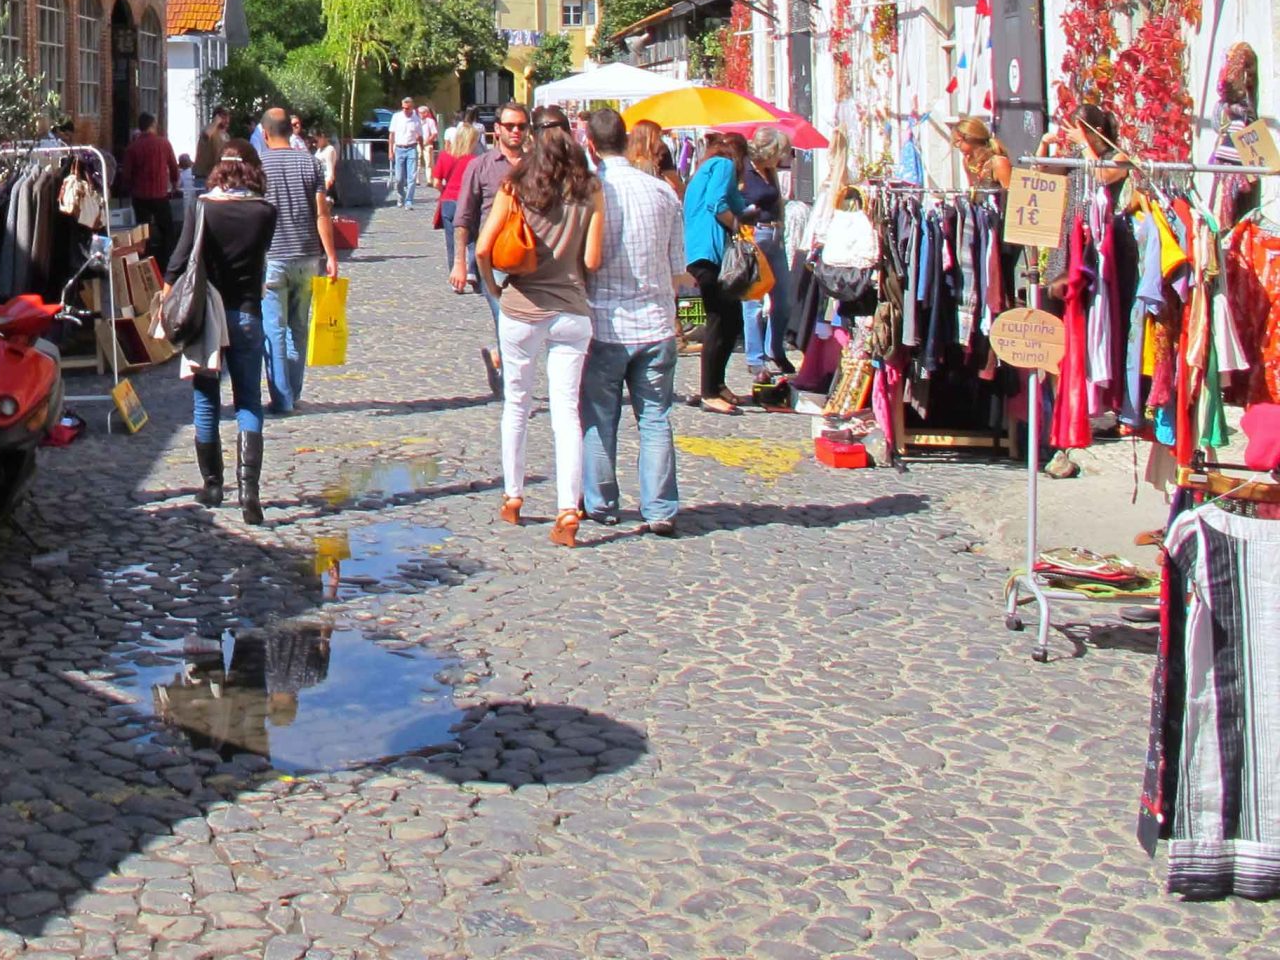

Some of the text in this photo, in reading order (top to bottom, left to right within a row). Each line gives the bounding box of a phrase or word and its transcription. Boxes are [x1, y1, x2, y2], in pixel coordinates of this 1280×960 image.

[1021, 176, 1056, 192] TUDO
[1027, 193, 1038, 207] A
[1016, 206, 1040, 226] 1€
[1001, 320, 1055, 338] roupinha
[997, 338, 1042, 351] que um
[1011, 350, 1050, 363] mimo!
